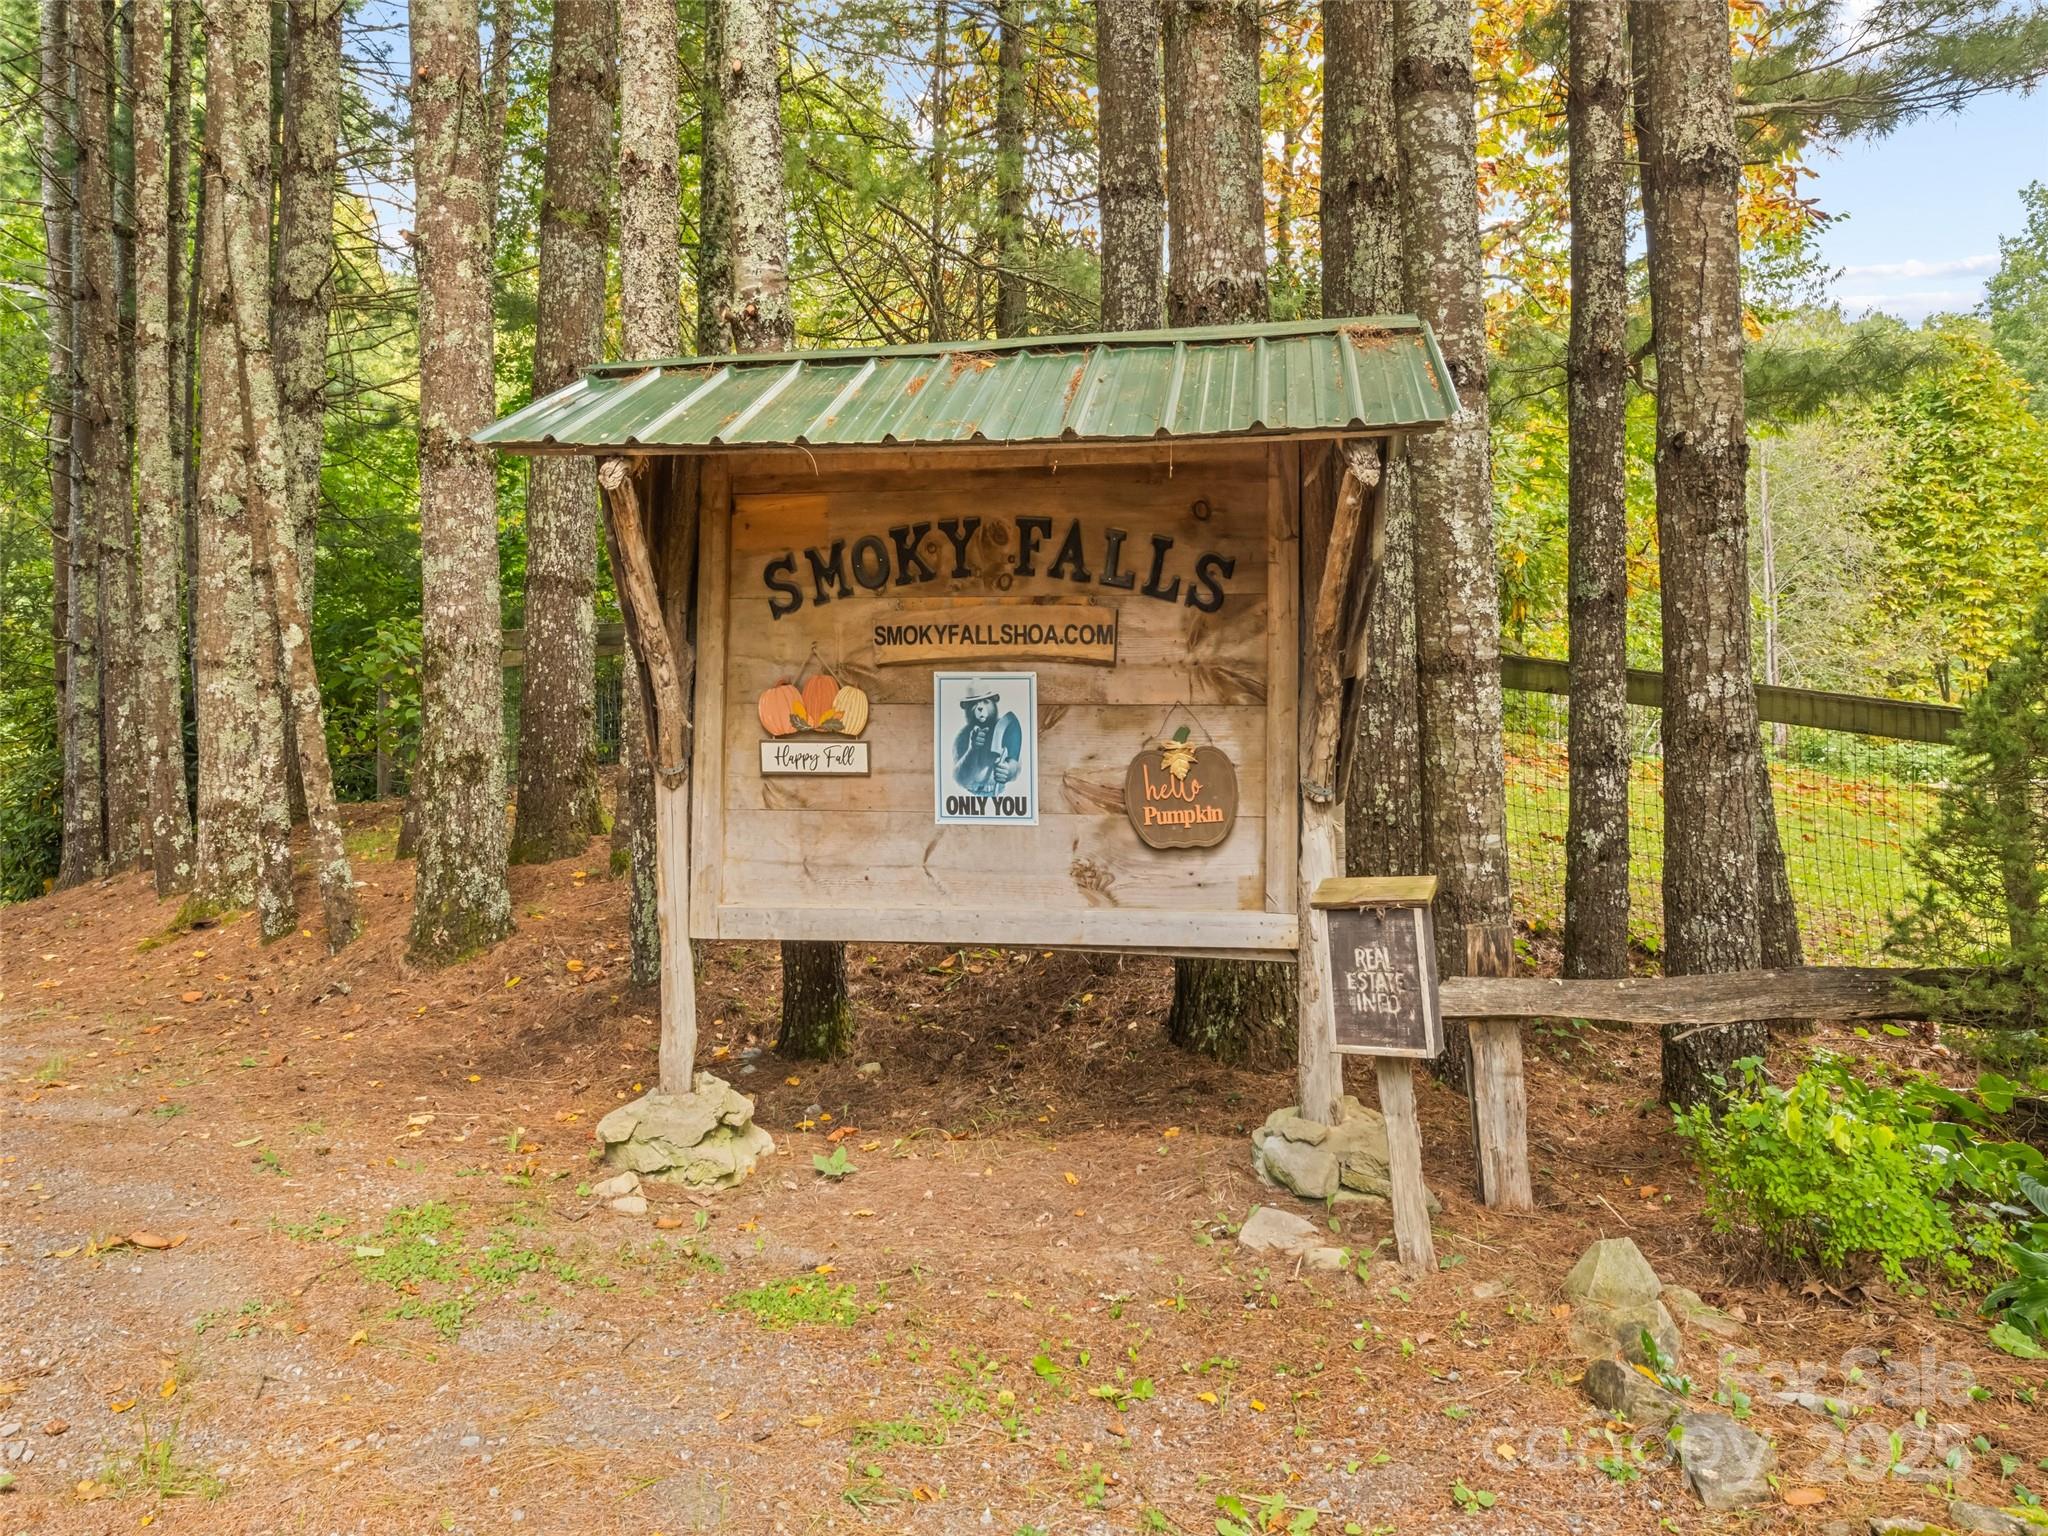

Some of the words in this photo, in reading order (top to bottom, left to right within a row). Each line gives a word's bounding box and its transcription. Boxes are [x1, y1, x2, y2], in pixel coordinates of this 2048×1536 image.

[763, 516, 982, 620] SMOKY
[1014, 515, 1236, 613] FALLS
[873, 623, 1114, 646] SMOKYFALLSHOA.COM
[774, 744, 820, 771] Happy
[823, 744, 856, 768] Fall
[1143, 763, 1203, 802] hello
[945, 795, 988, 816] ONLY
[992, 795, 1027, 816] YOU
[1143, 803, 1224, 829] Pumpkin
[1354, 947, 1395, 971] REAL
[1346, 971, 1406, 993] ESTATE
